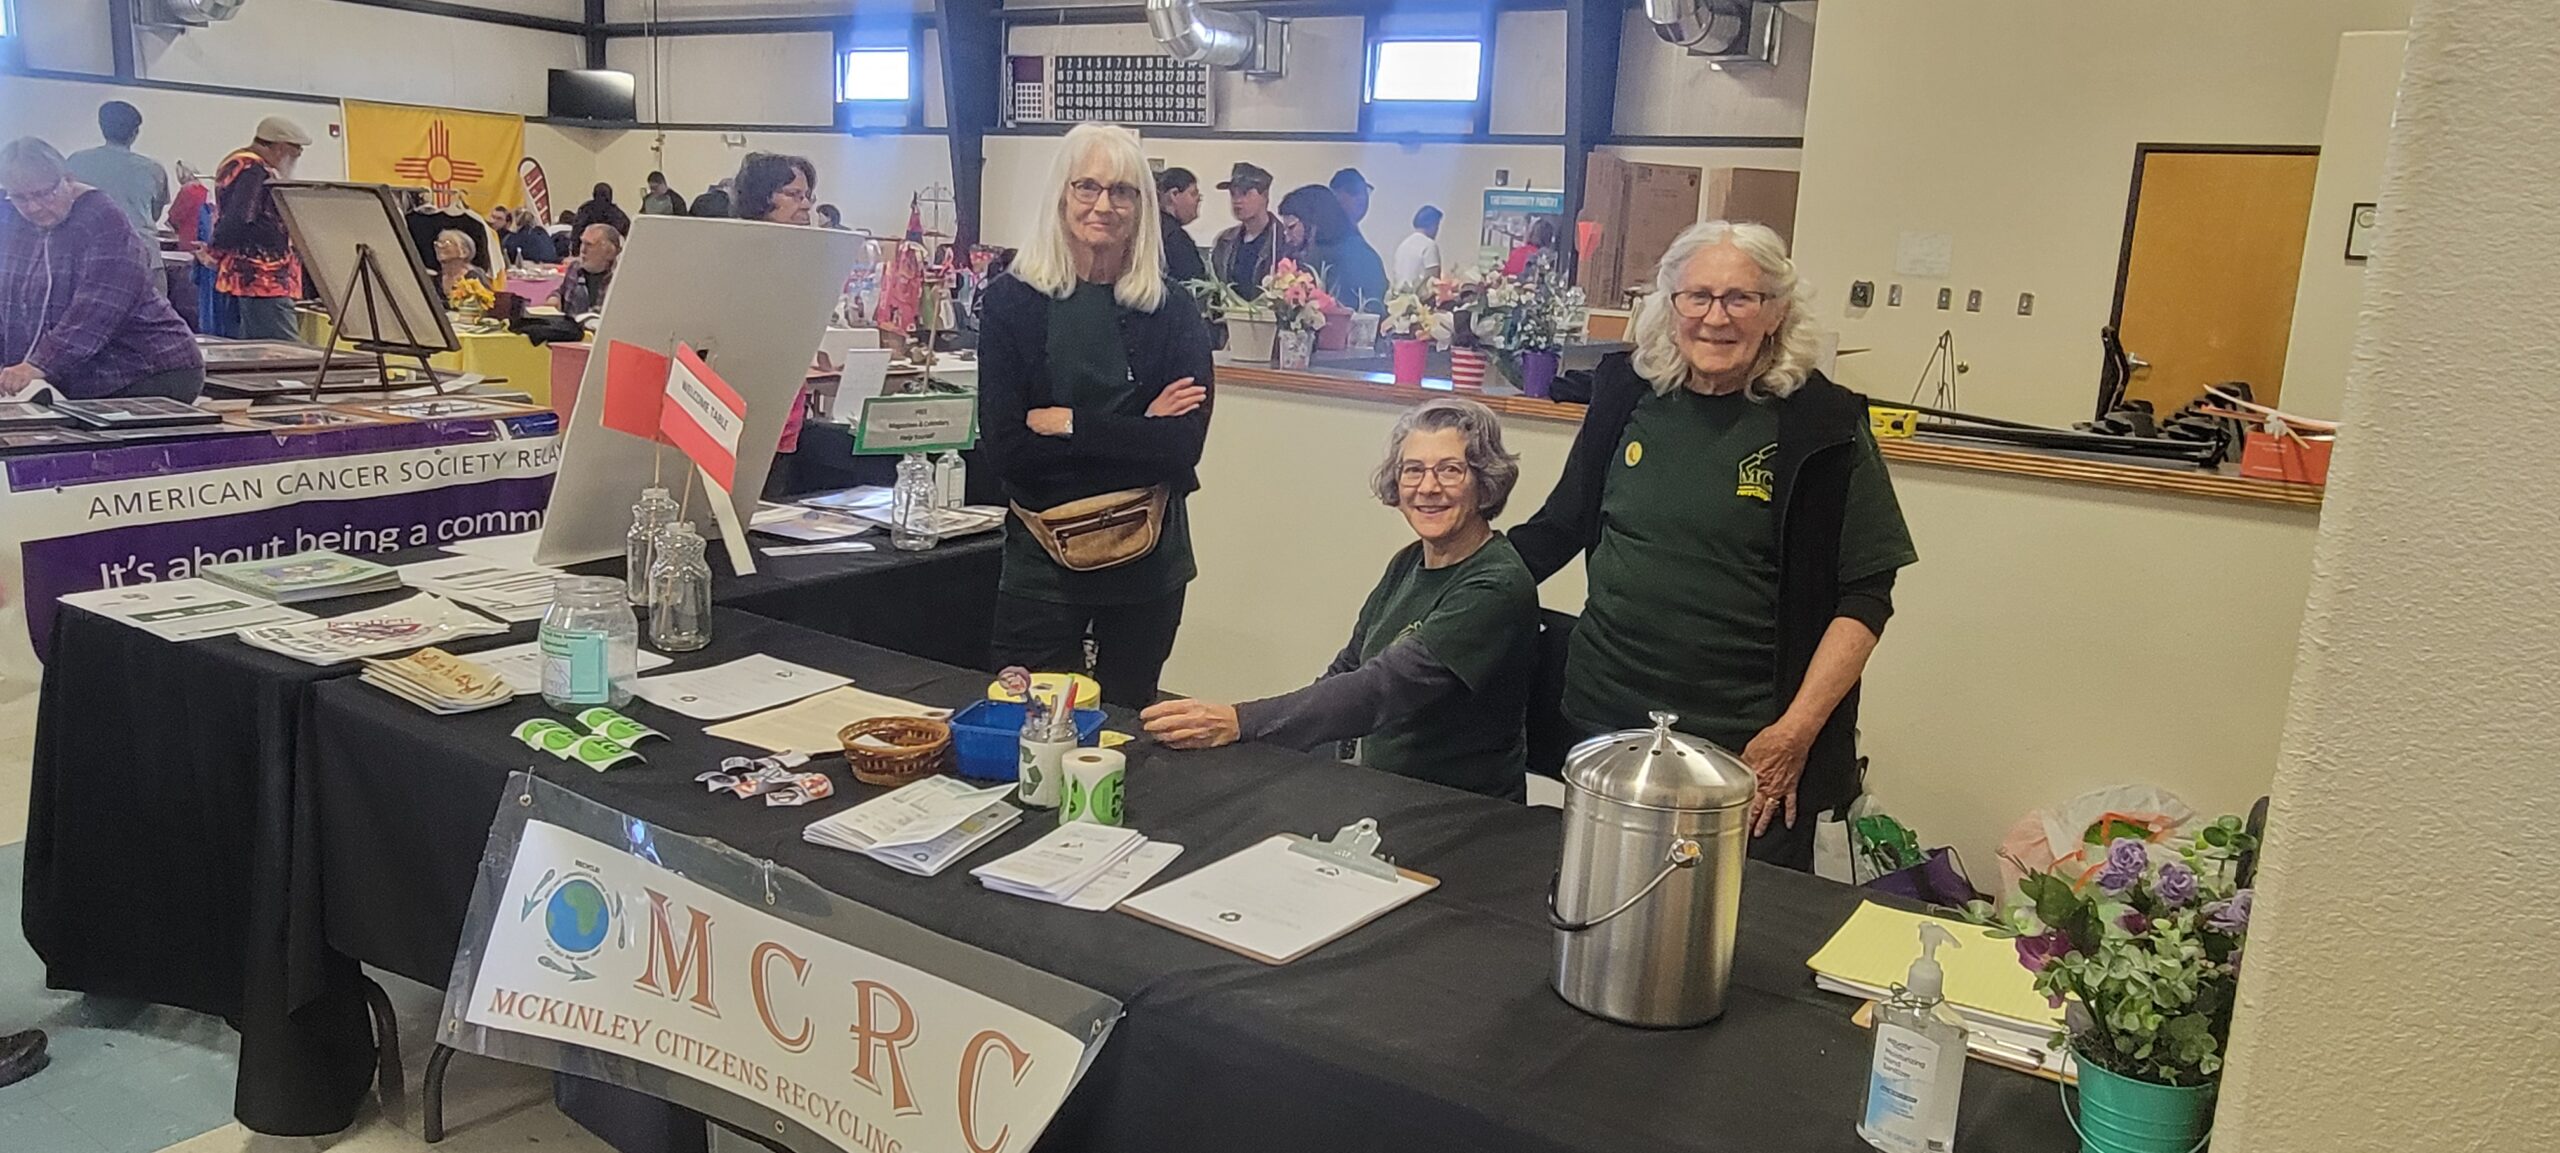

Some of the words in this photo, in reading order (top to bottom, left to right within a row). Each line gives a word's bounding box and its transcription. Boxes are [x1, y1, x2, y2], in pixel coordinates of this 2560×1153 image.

[710, 406, 730, 431] TABLE
[88, 478, 263, 520] AMERICAN
[276, 464, 389, 496] CANCER
[399, 450, 507, 483] SOCIETY
[100, 554, 158, 590] It's
[296, 524, 401, 555] being
[409, 524, 428, 546] a
[488, 987, 653, 1047] MCKINLEY
[655, 1027, 769, 1092] CITIZENS
